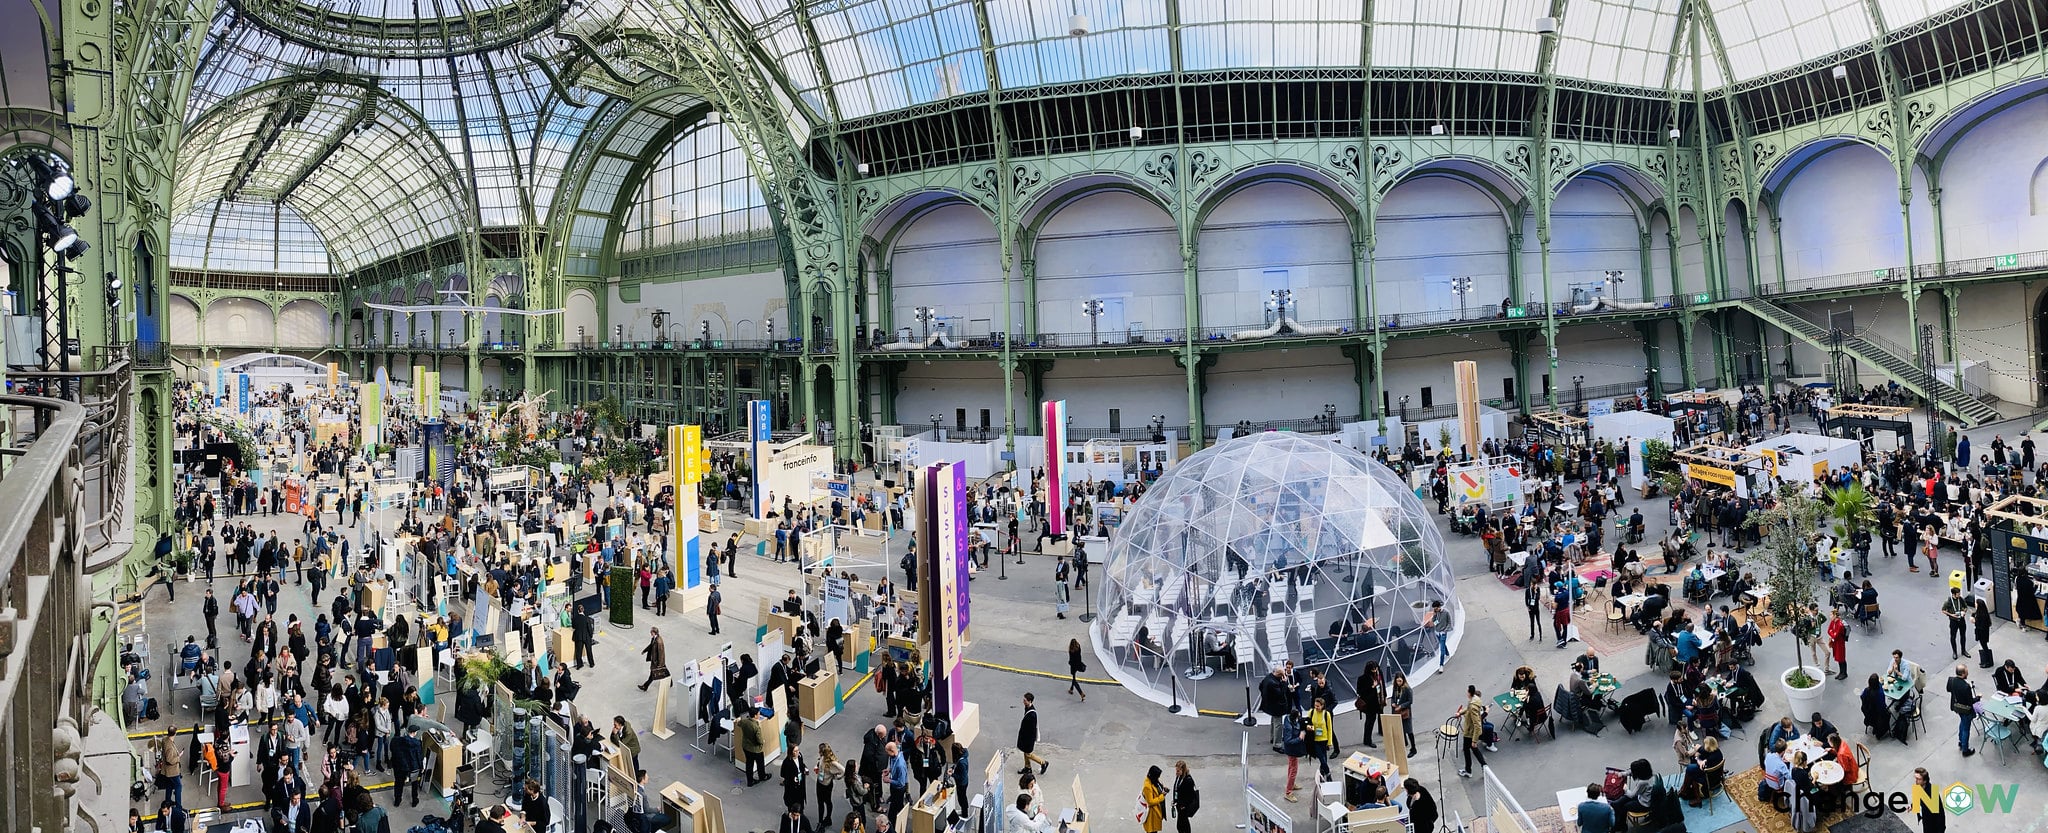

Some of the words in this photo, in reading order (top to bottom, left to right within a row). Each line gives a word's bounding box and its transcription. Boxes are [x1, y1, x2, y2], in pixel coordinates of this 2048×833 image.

[687, 431, 695, 505] ENERGY
[783, 453, 818, 471] franceinfo
[956, 478, 963, 492] &
[943, 486, 954, 660] SUSTAINABLE
[957, 501, 967, 626] FASHION
